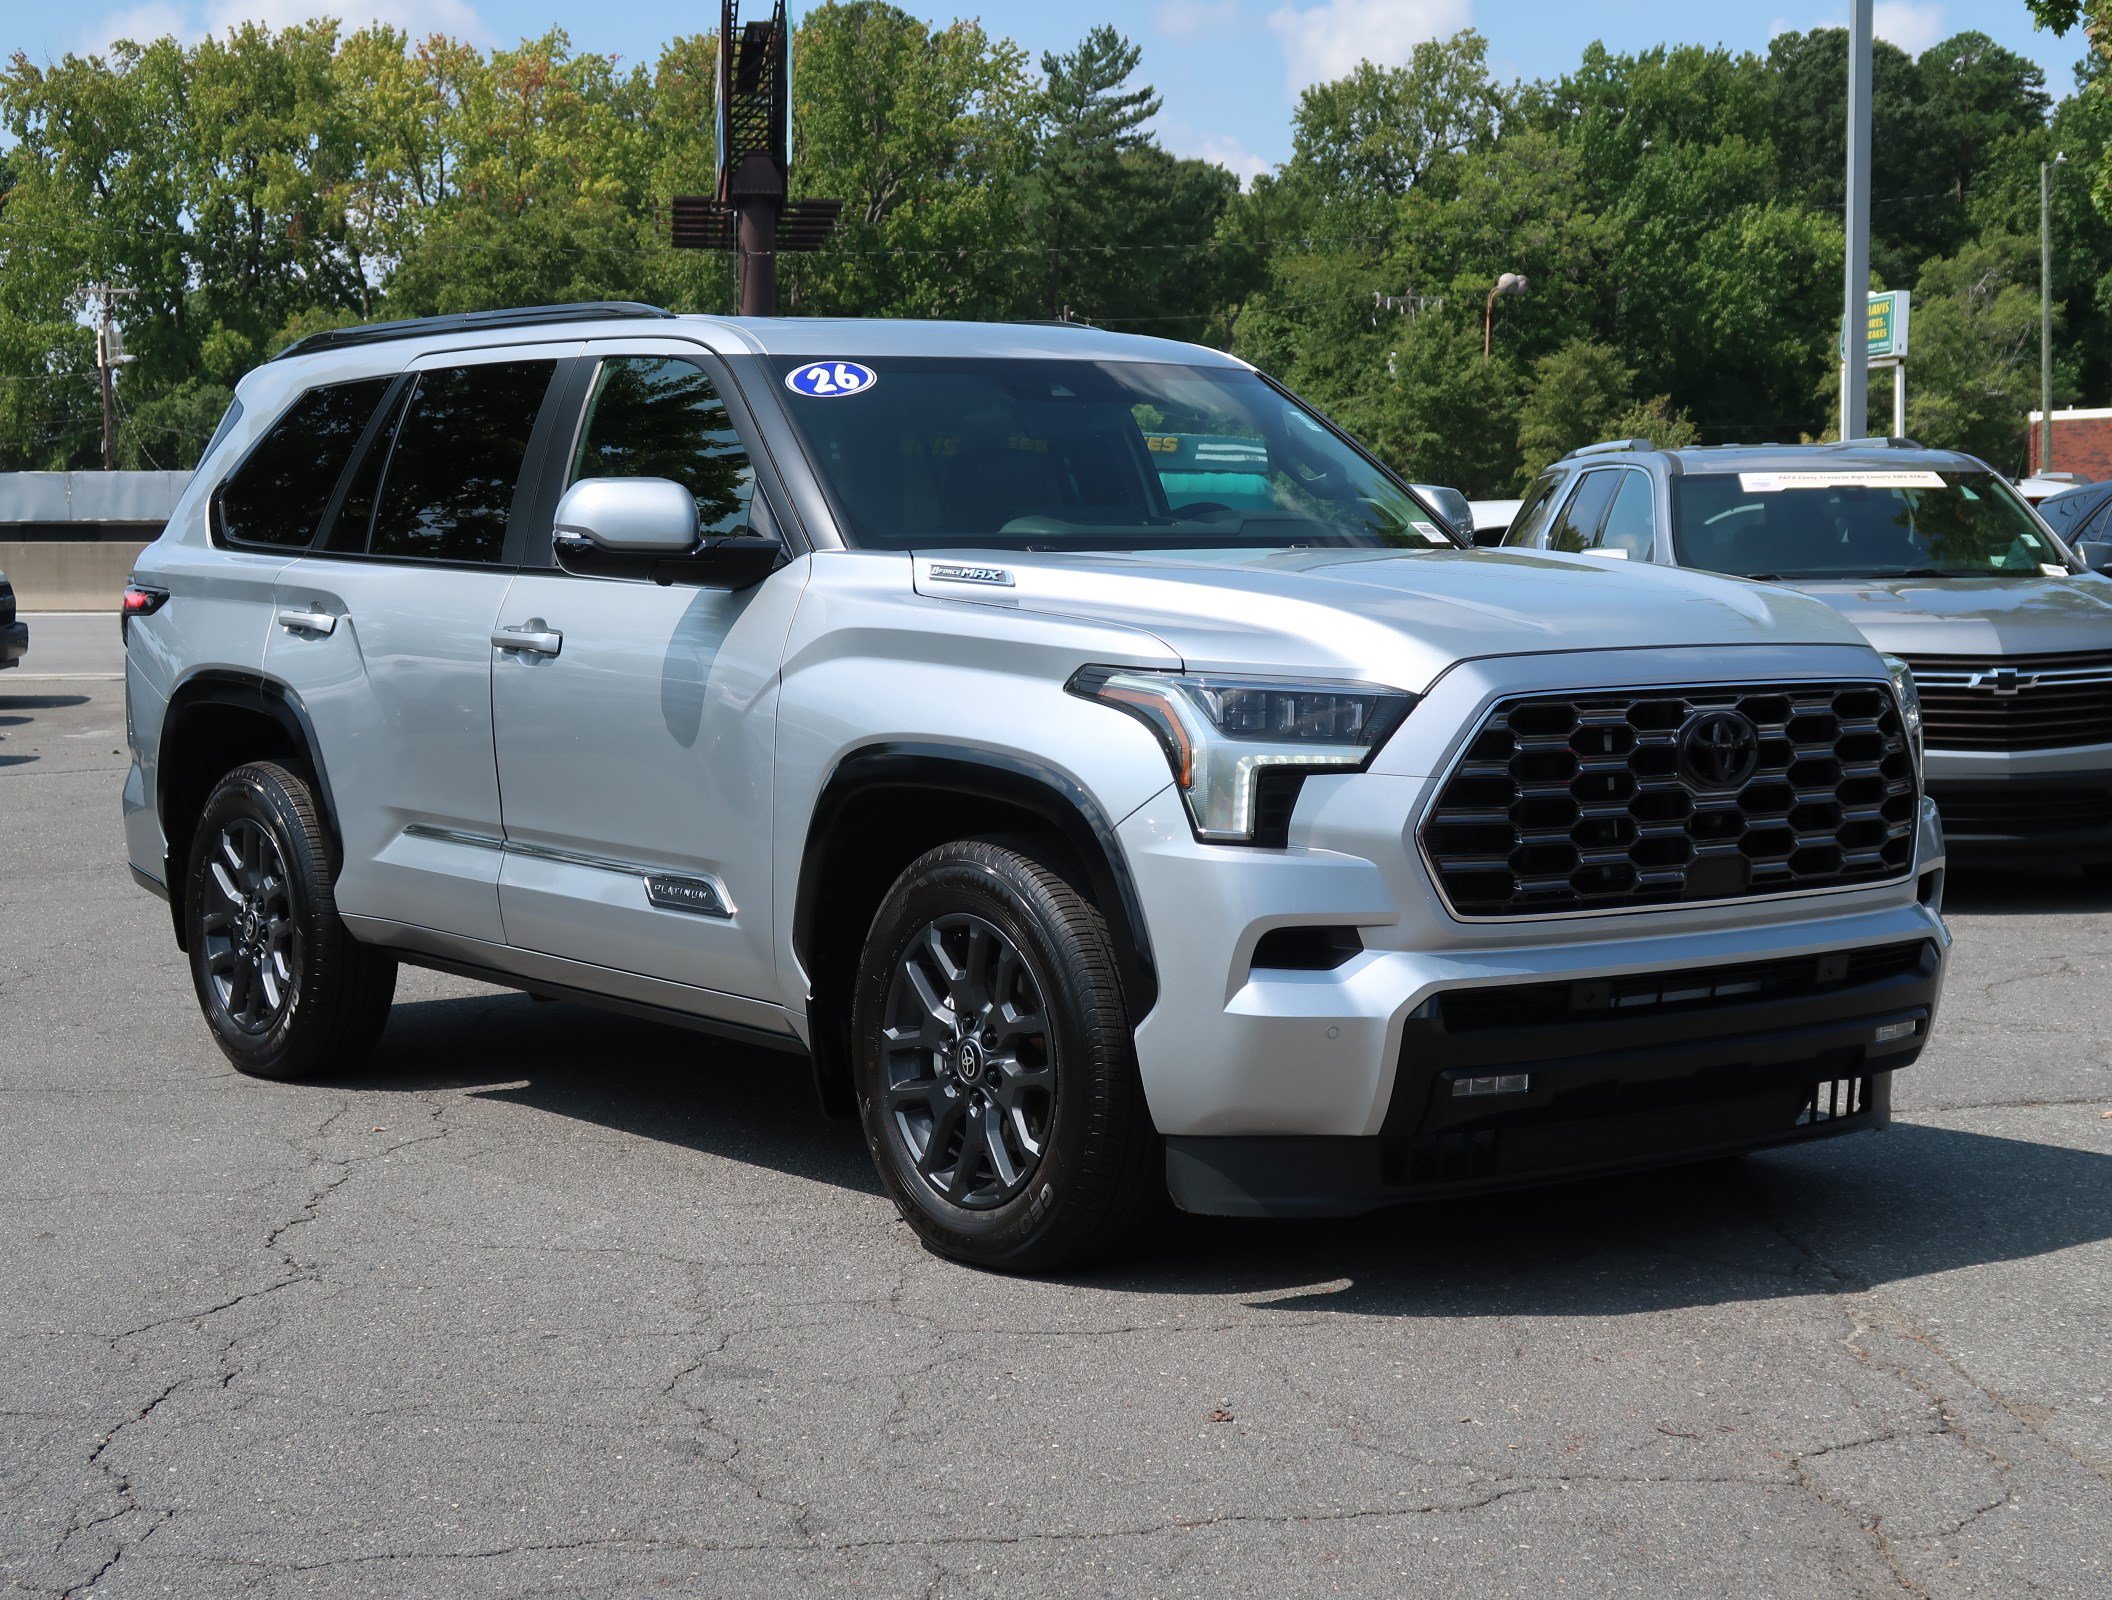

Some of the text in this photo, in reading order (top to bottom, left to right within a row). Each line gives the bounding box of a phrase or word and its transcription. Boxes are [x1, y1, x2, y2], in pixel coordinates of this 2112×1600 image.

[1867, 300, 1890, 316] AVIS
[1867, 328, 1888, 340] RAKES
[806, 363, 860, 393] 26
[960, 567, 999, 580] MAX
[654, 884, 708, 899] PLATINUM
